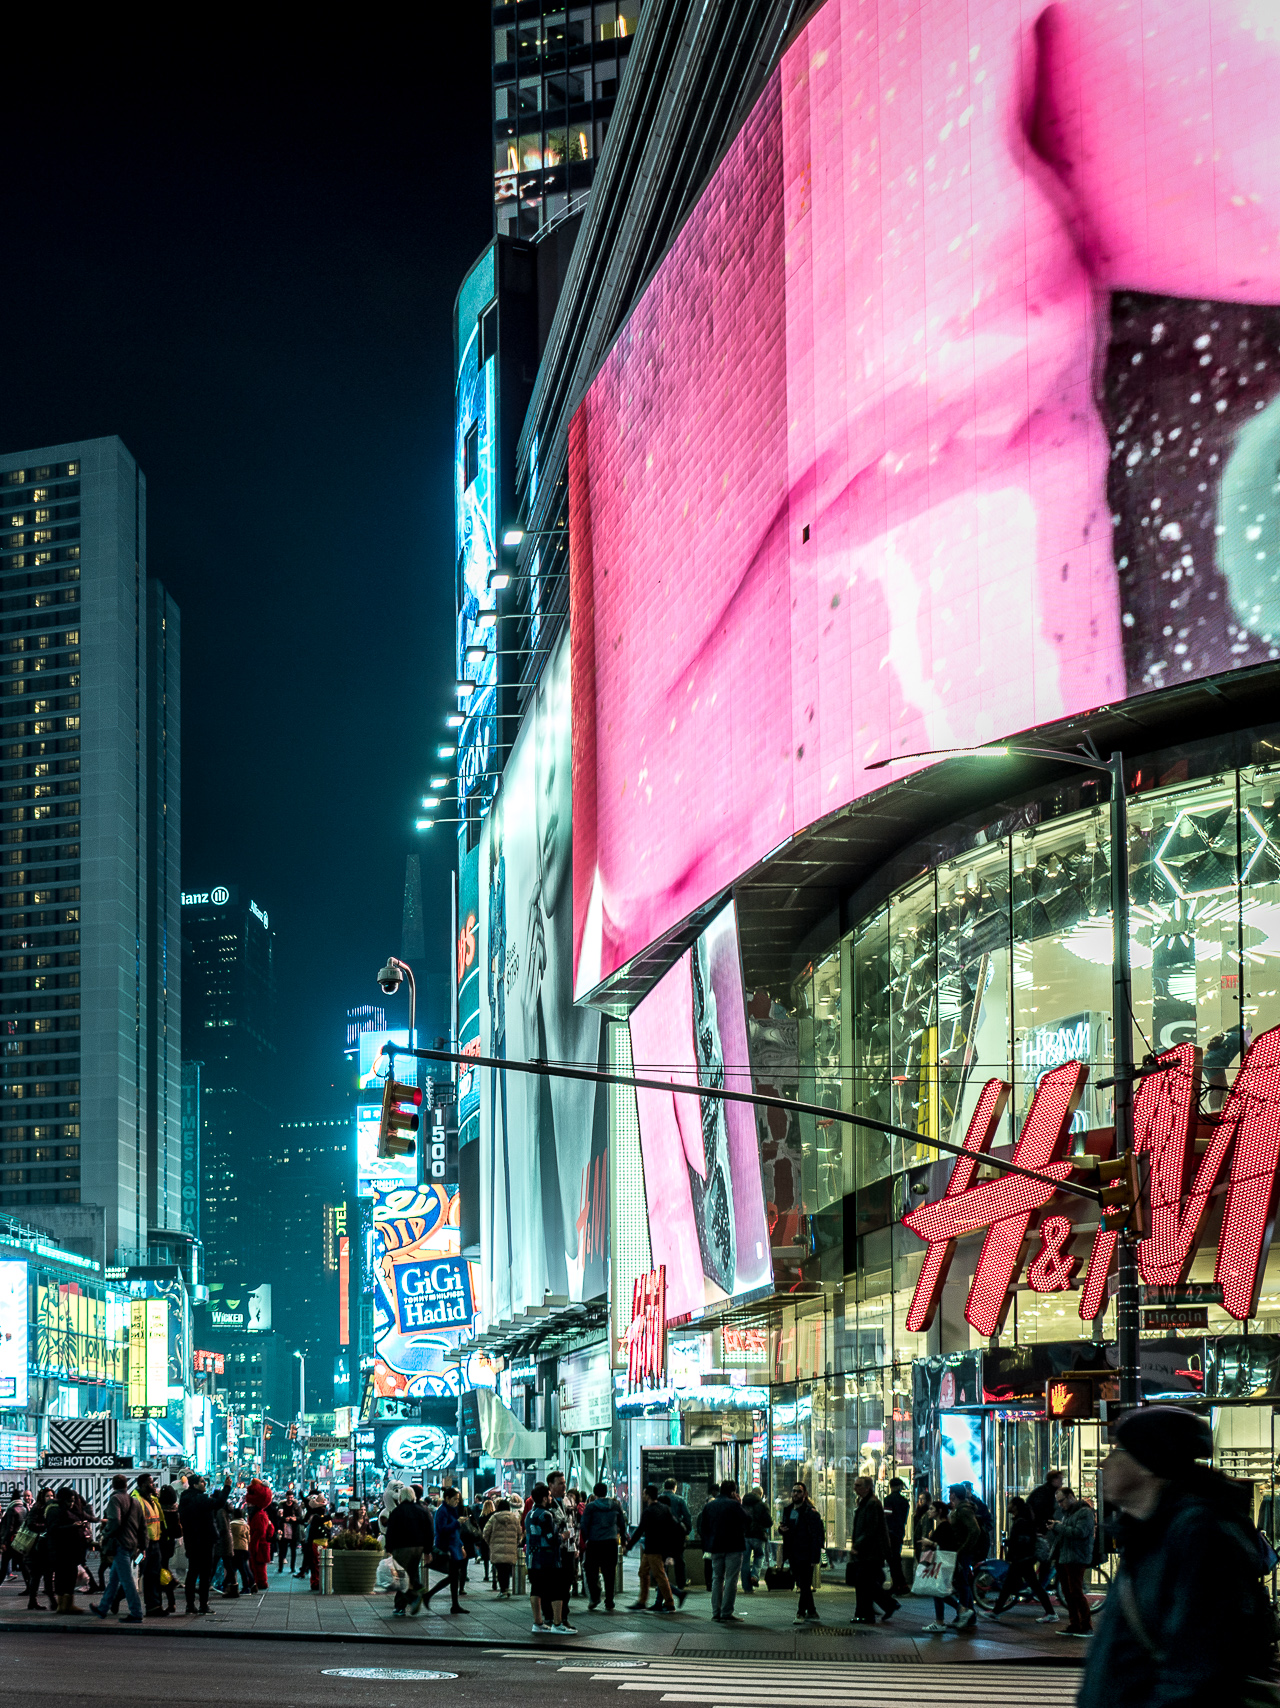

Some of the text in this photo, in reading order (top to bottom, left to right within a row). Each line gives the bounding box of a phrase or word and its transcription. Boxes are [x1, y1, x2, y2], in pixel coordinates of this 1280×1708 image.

[1221, 975, 1239, 989] EXIT
[432, 1108, 446, 1178] 1500
[370, 1179, 404, 1188] XINHUA
[901, 1025, 1280, 1338] H&M
[1162, 1286, 1176, 1303] W
[1185, 1285, 1204, 1302] 42
[404, 1298, 468, 1327] Hadid
[1148, 1311, 1202, 1323] Lincoln
[63, 1456, 85, 1466] HOT
[85, 1456, 115, 1466] DOGS
